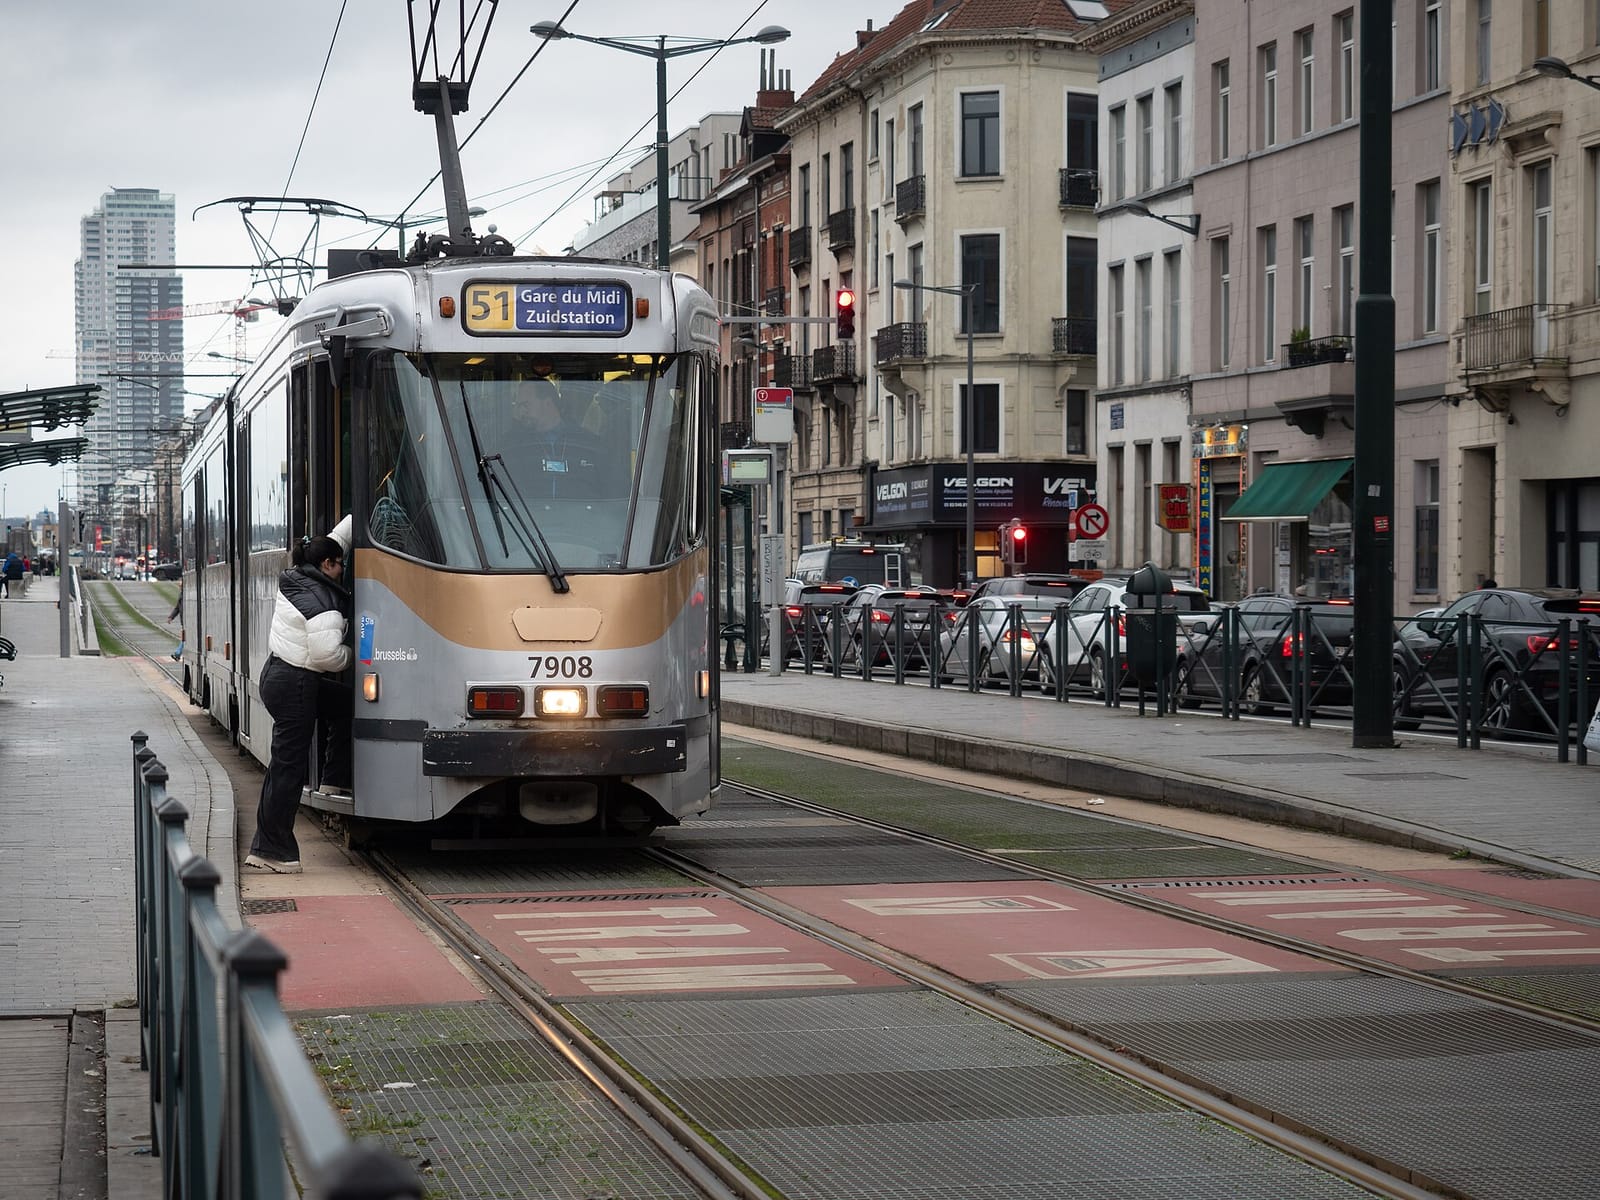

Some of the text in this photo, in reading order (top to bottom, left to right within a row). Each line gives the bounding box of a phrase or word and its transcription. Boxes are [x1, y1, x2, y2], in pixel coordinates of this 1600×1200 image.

[471, 289, 621, 321] 51 Gare du Midi
[526, 309, 615, 325] Zuidstation
[876, 481, 908, 502] VELGON
[943, 477, 1013, 487] VEGON
[1200, 464, 1210, 519] SUPER
[1167, 501, 1188, 516] CAR
[527, 656, 594, 679] 7908
[493, 906, 857, 993] TRAM
